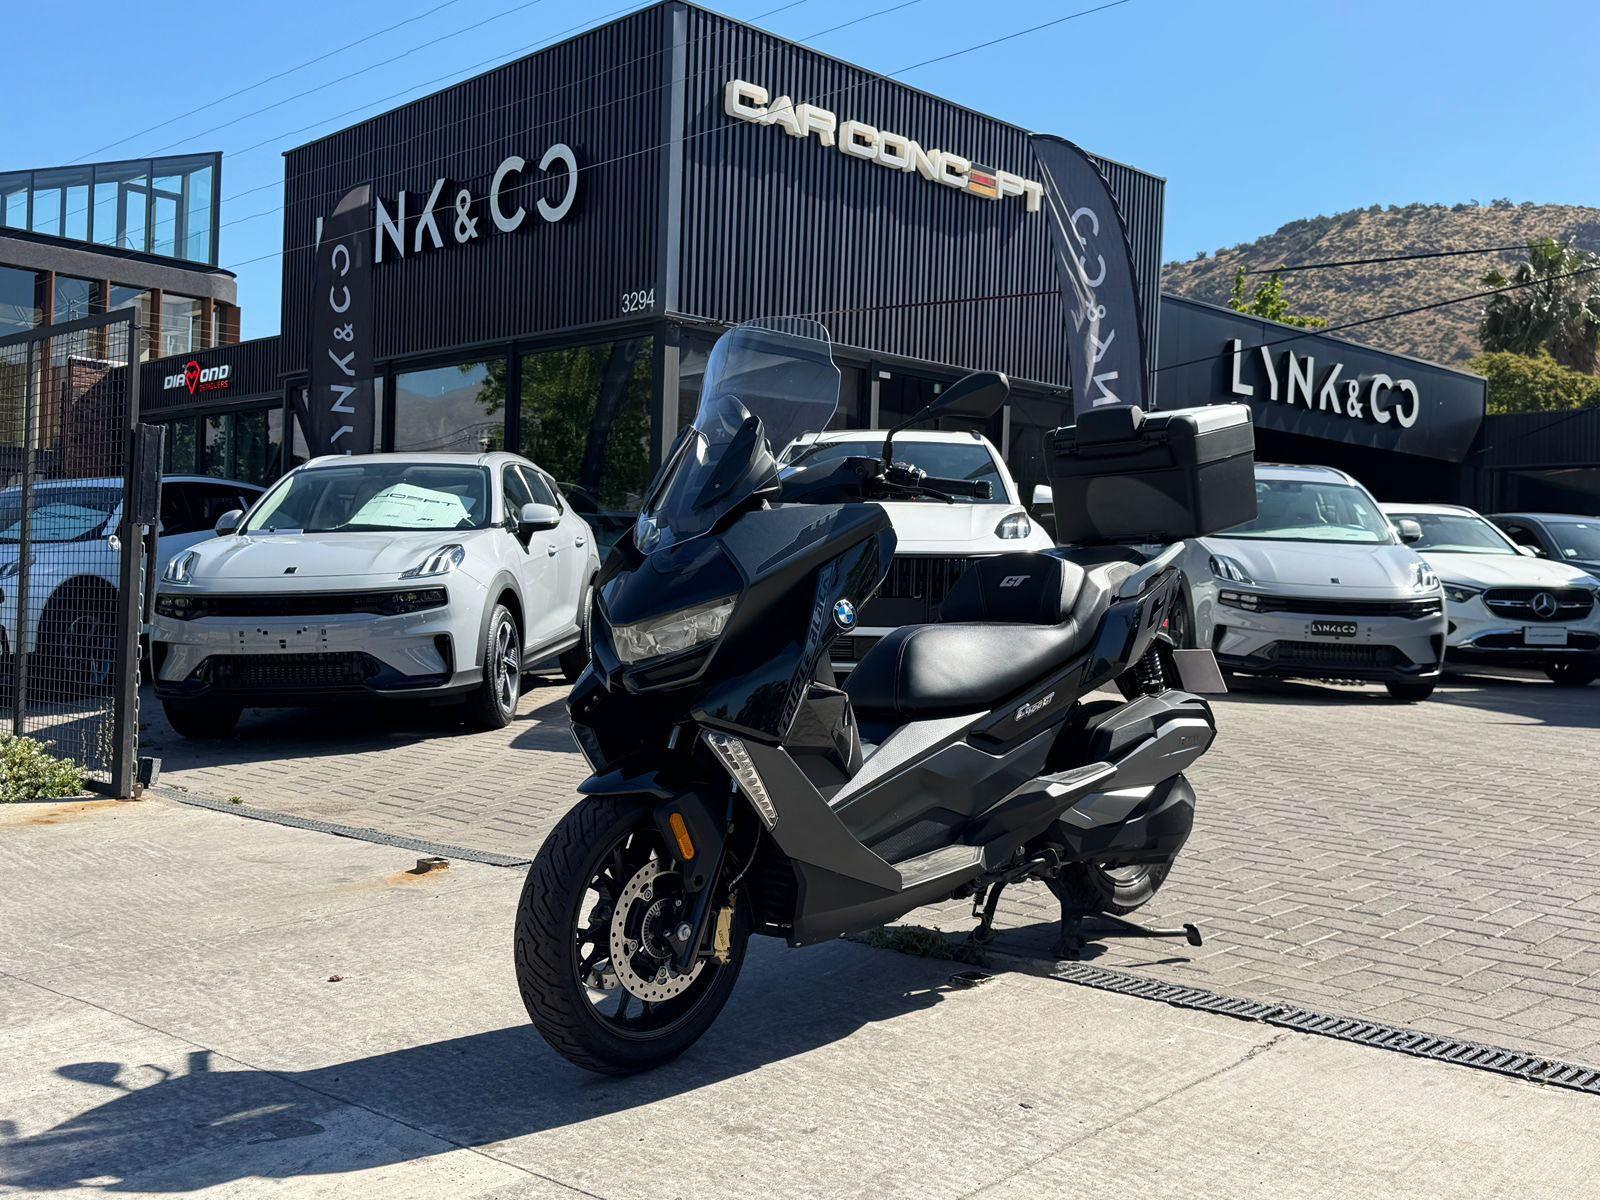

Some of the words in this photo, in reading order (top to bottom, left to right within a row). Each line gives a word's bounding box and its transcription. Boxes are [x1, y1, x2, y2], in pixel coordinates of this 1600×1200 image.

[725, 79, 836, 147] CAR
[839, 120, 1044, 212] CONCEPT
[622, 288, 655, 313] 3294
[1000, 575, 1032, 587] GT
